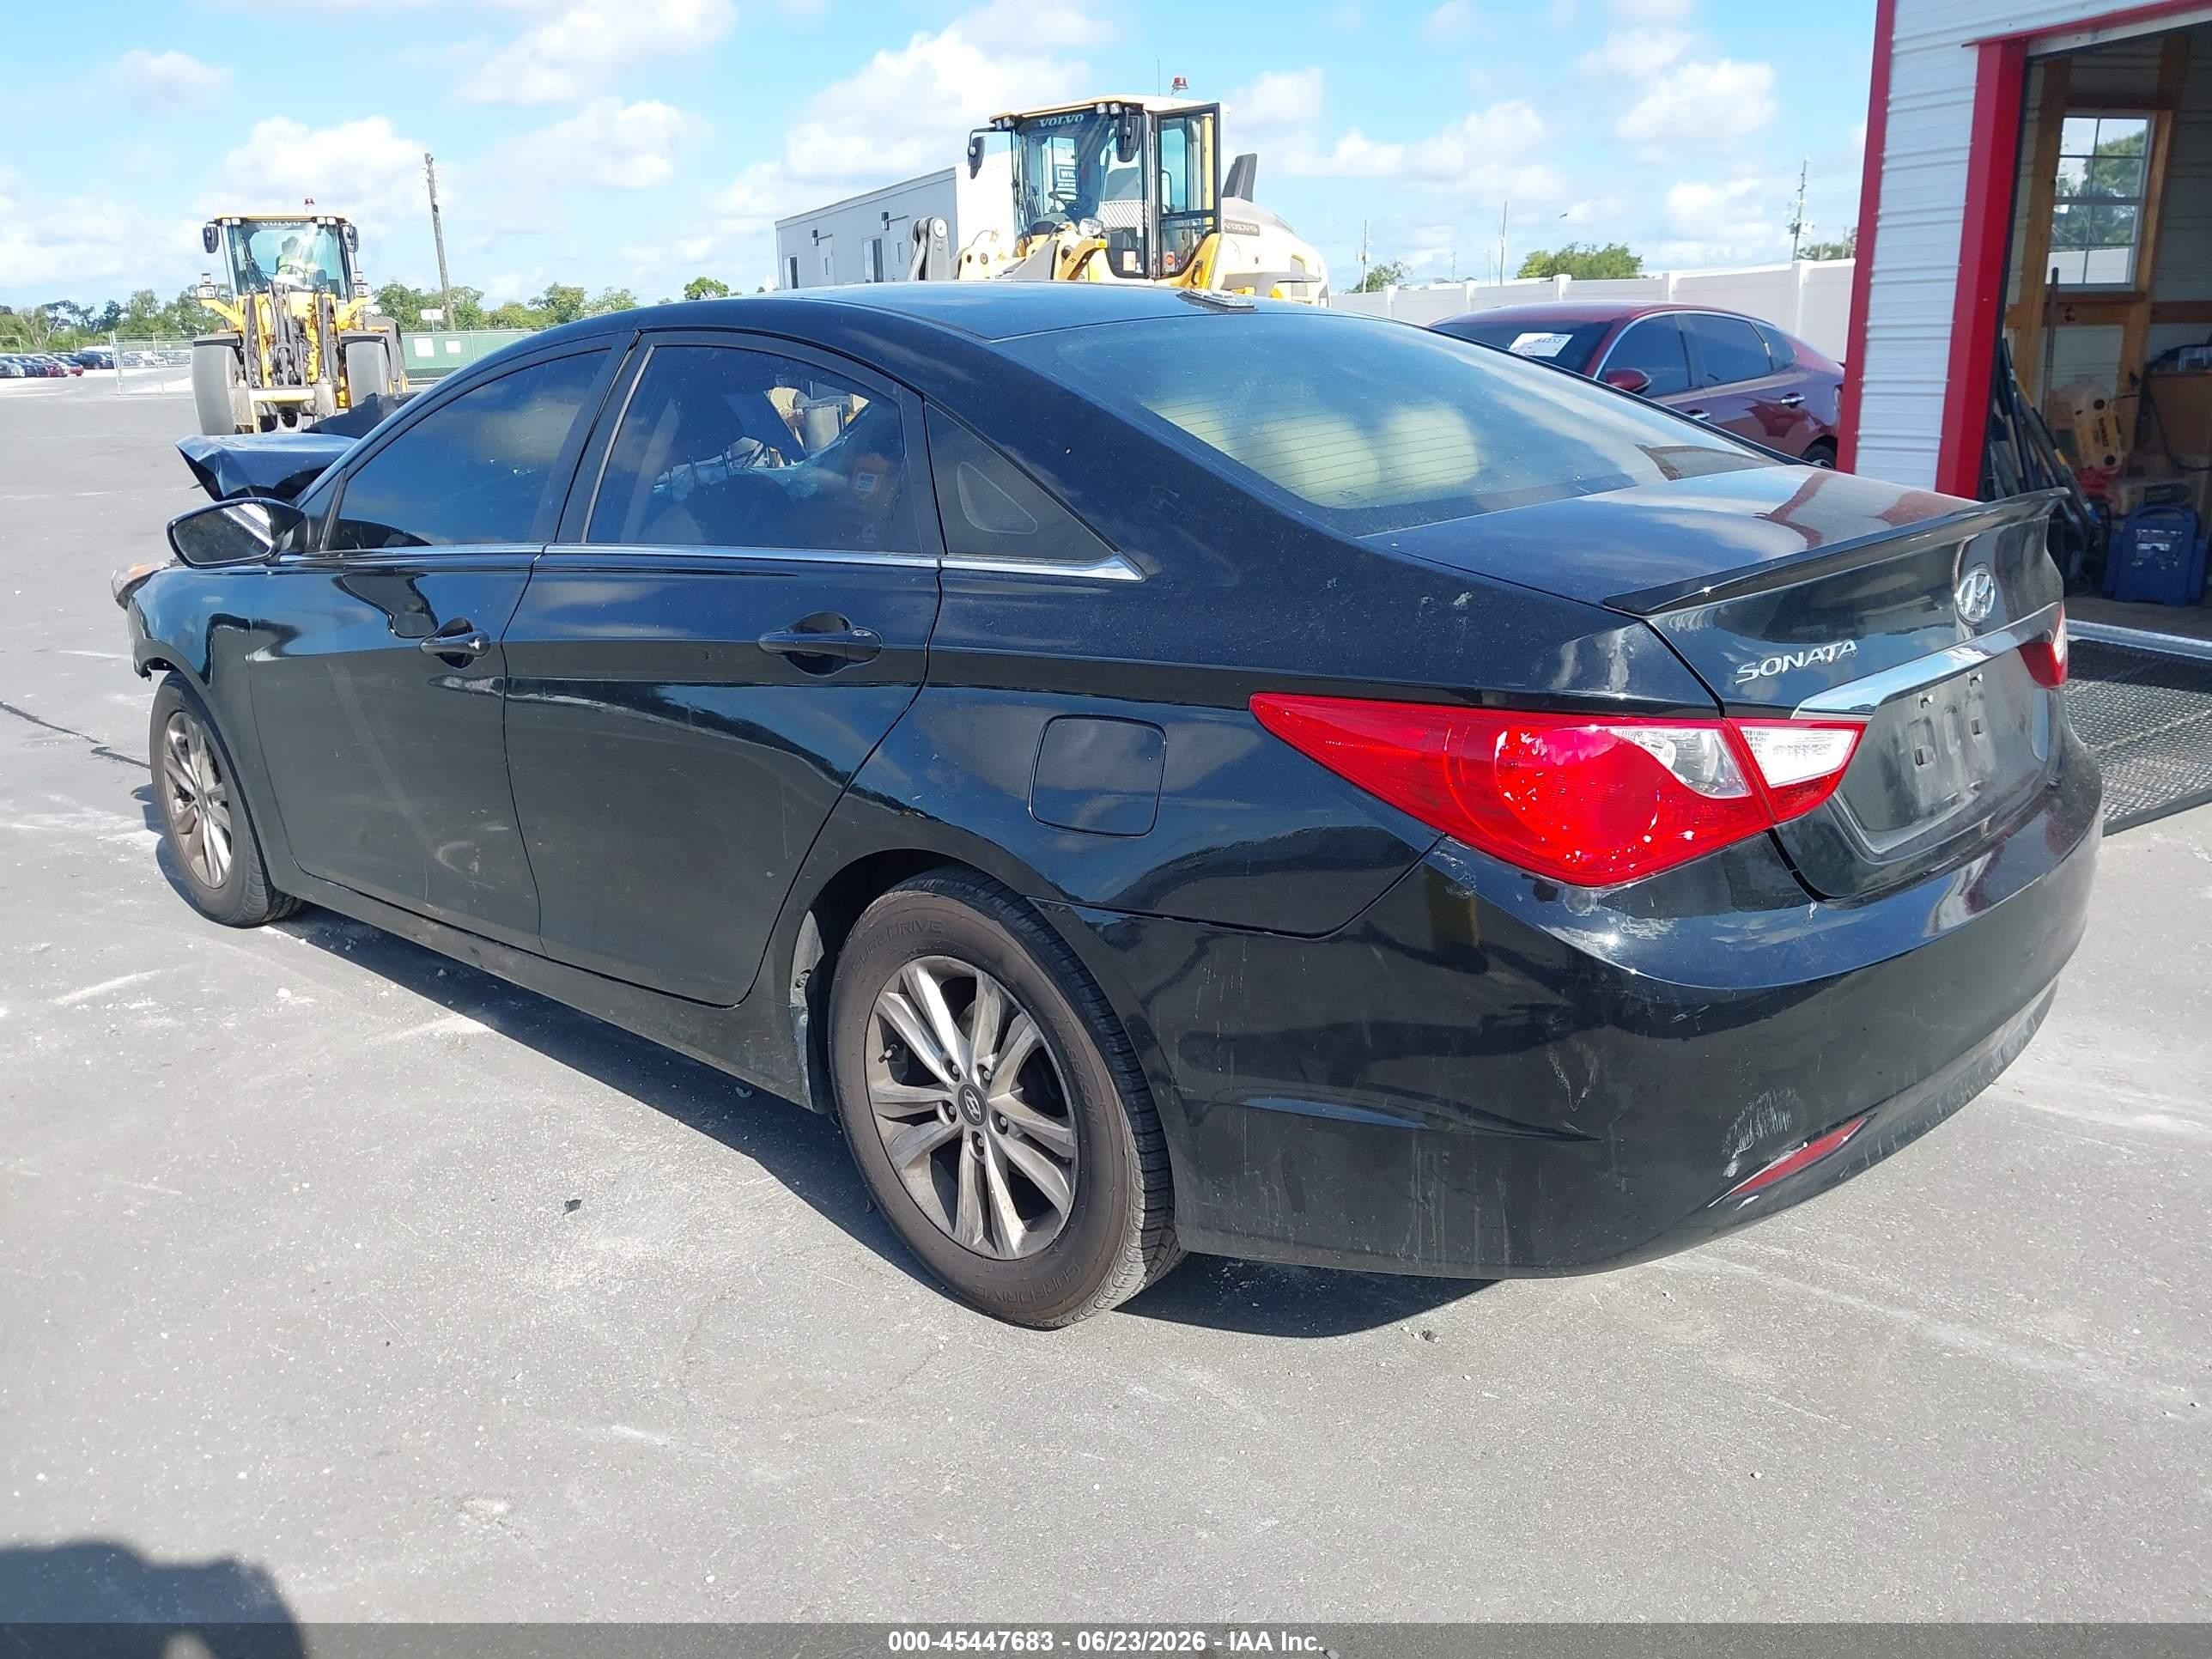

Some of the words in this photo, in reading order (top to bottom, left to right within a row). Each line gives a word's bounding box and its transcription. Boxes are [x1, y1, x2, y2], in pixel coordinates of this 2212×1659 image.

[1038, 113, 1085, 128] VOLVO
[1224, 222, 1258, 233] VOLVO
[1734, 639, 1858, 685] SONATA
